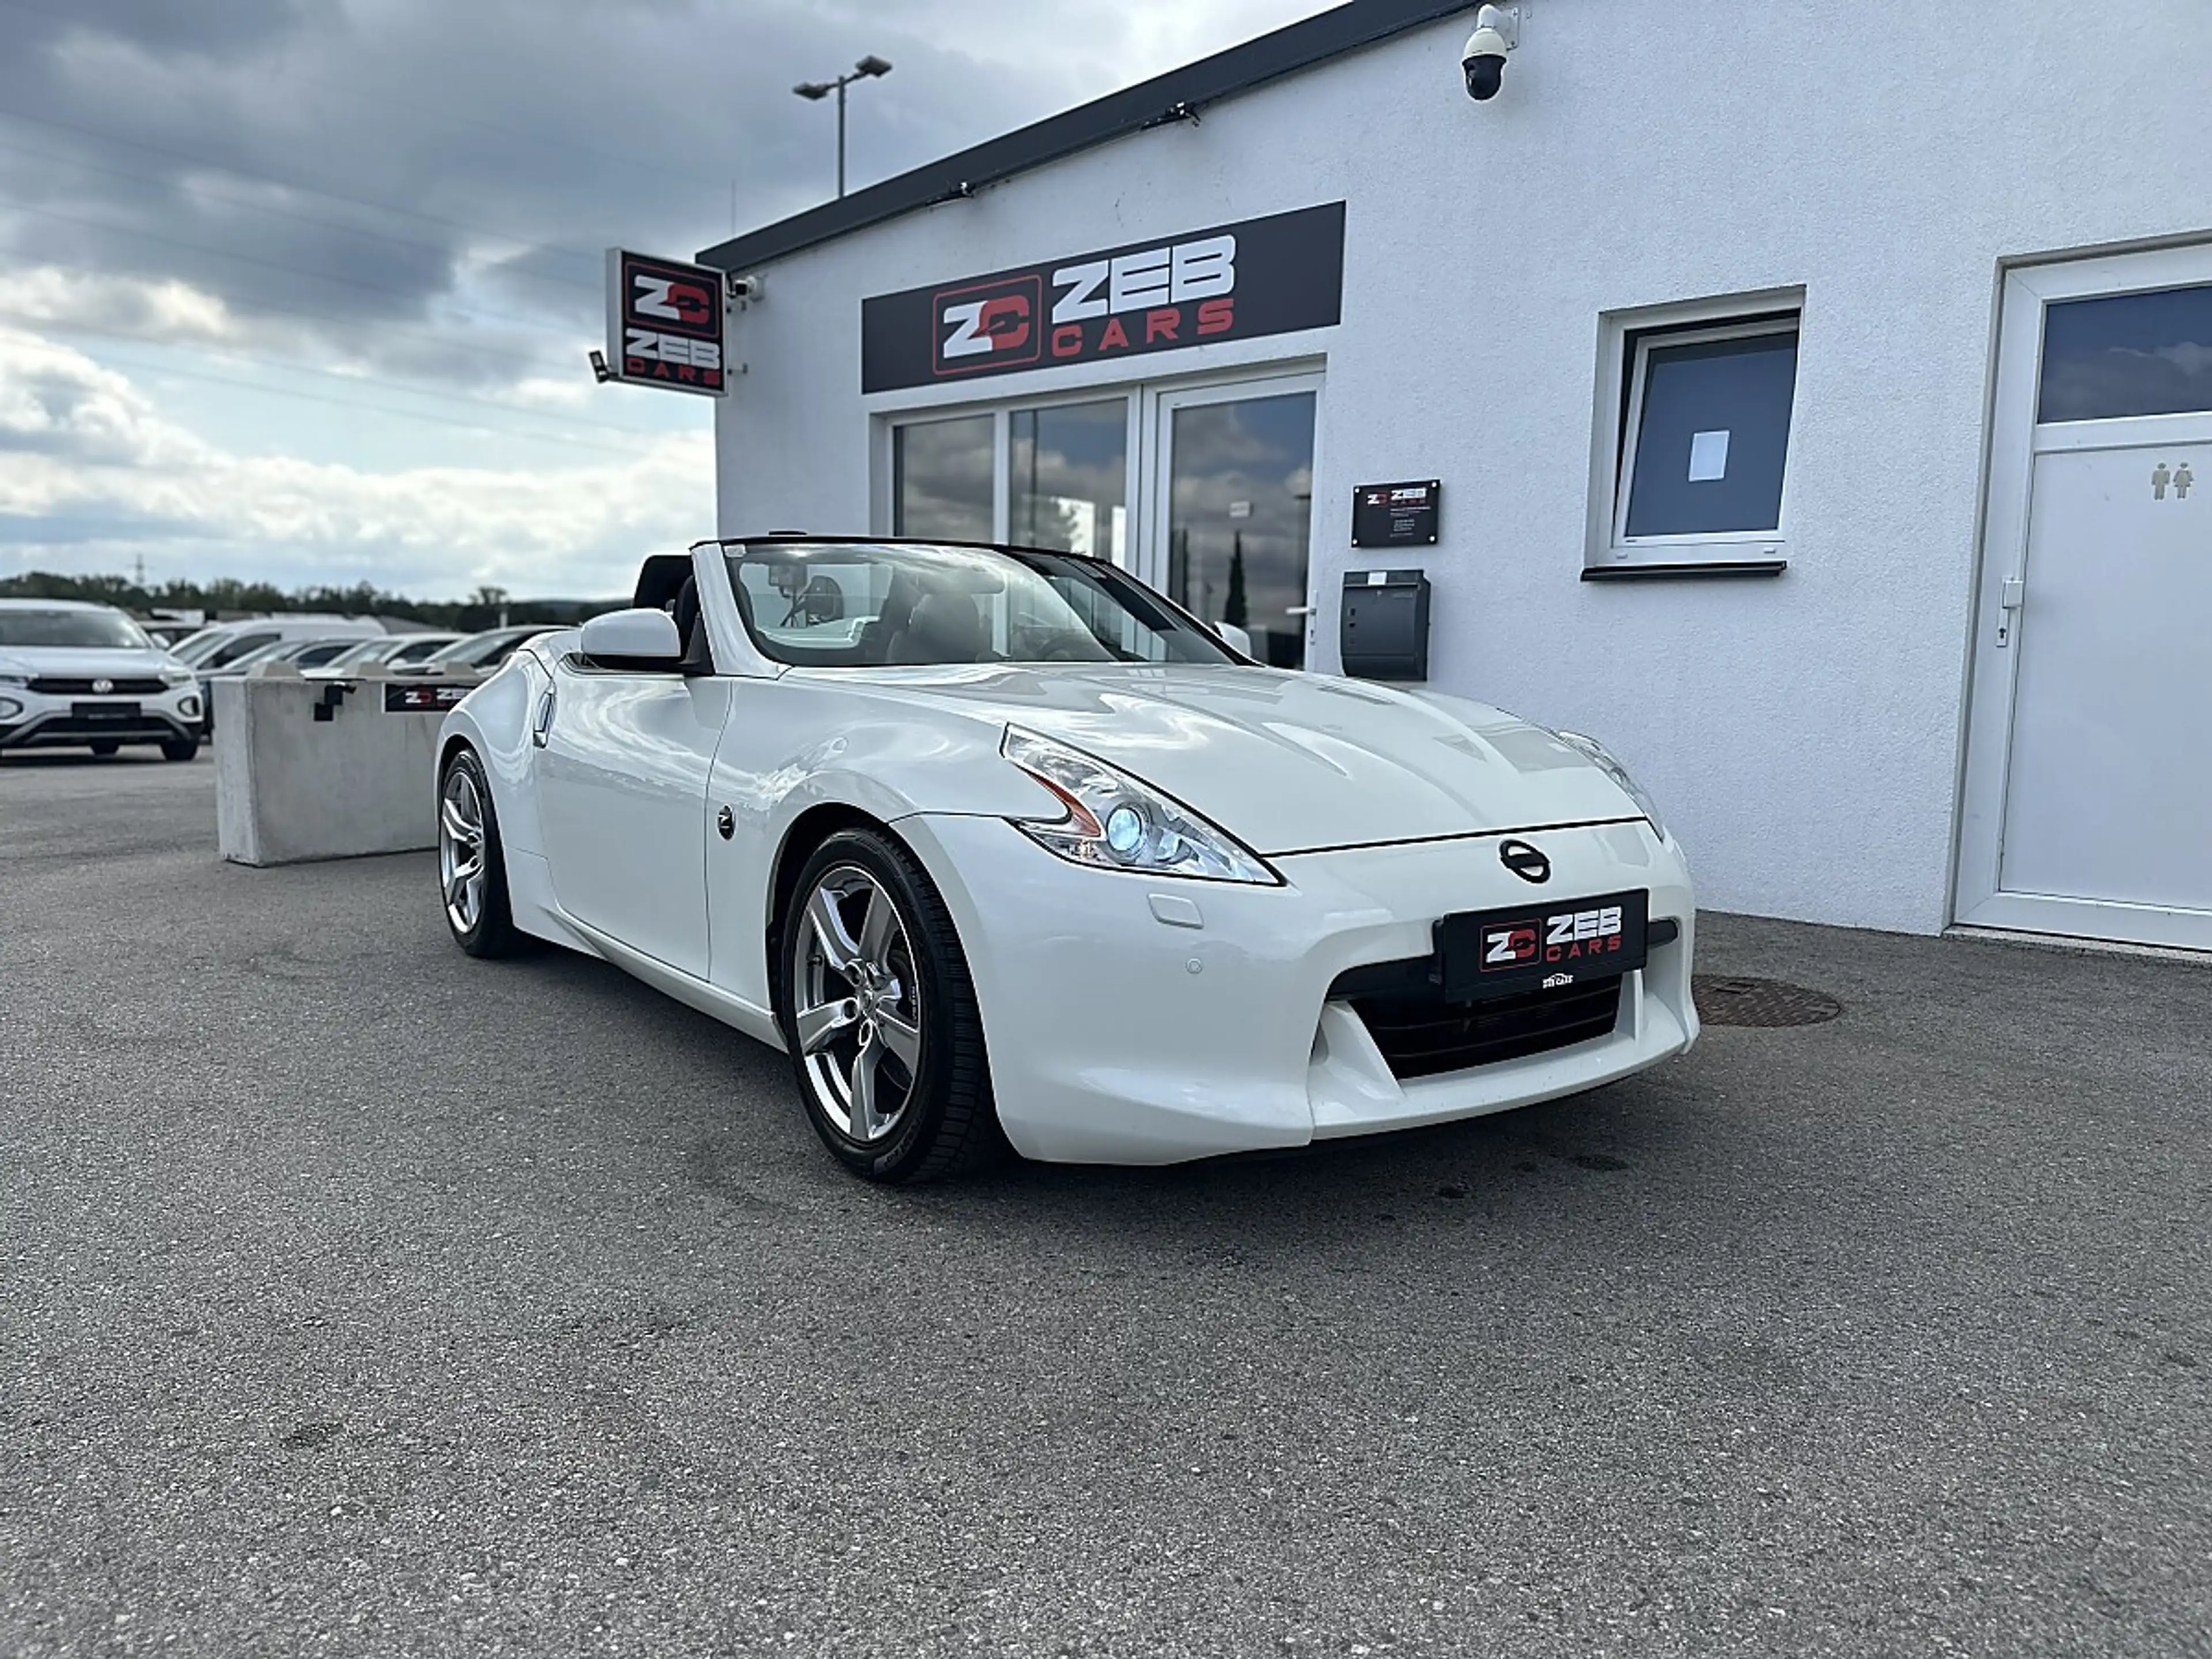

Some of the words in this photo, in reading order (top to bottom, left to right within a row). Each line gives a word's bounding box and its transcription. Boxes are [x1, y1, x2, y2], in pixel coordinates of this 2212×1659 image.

[1052, 234, 1237, 324] ZEB
[1051, 297, 1235, 358] CARS
[626, 327, 720, 369] ZEB
[627, 357, 721, 385] CARS
[1546, 906, 1622, 945] ZEB
[1546, 934, 1622, 963] CARS
